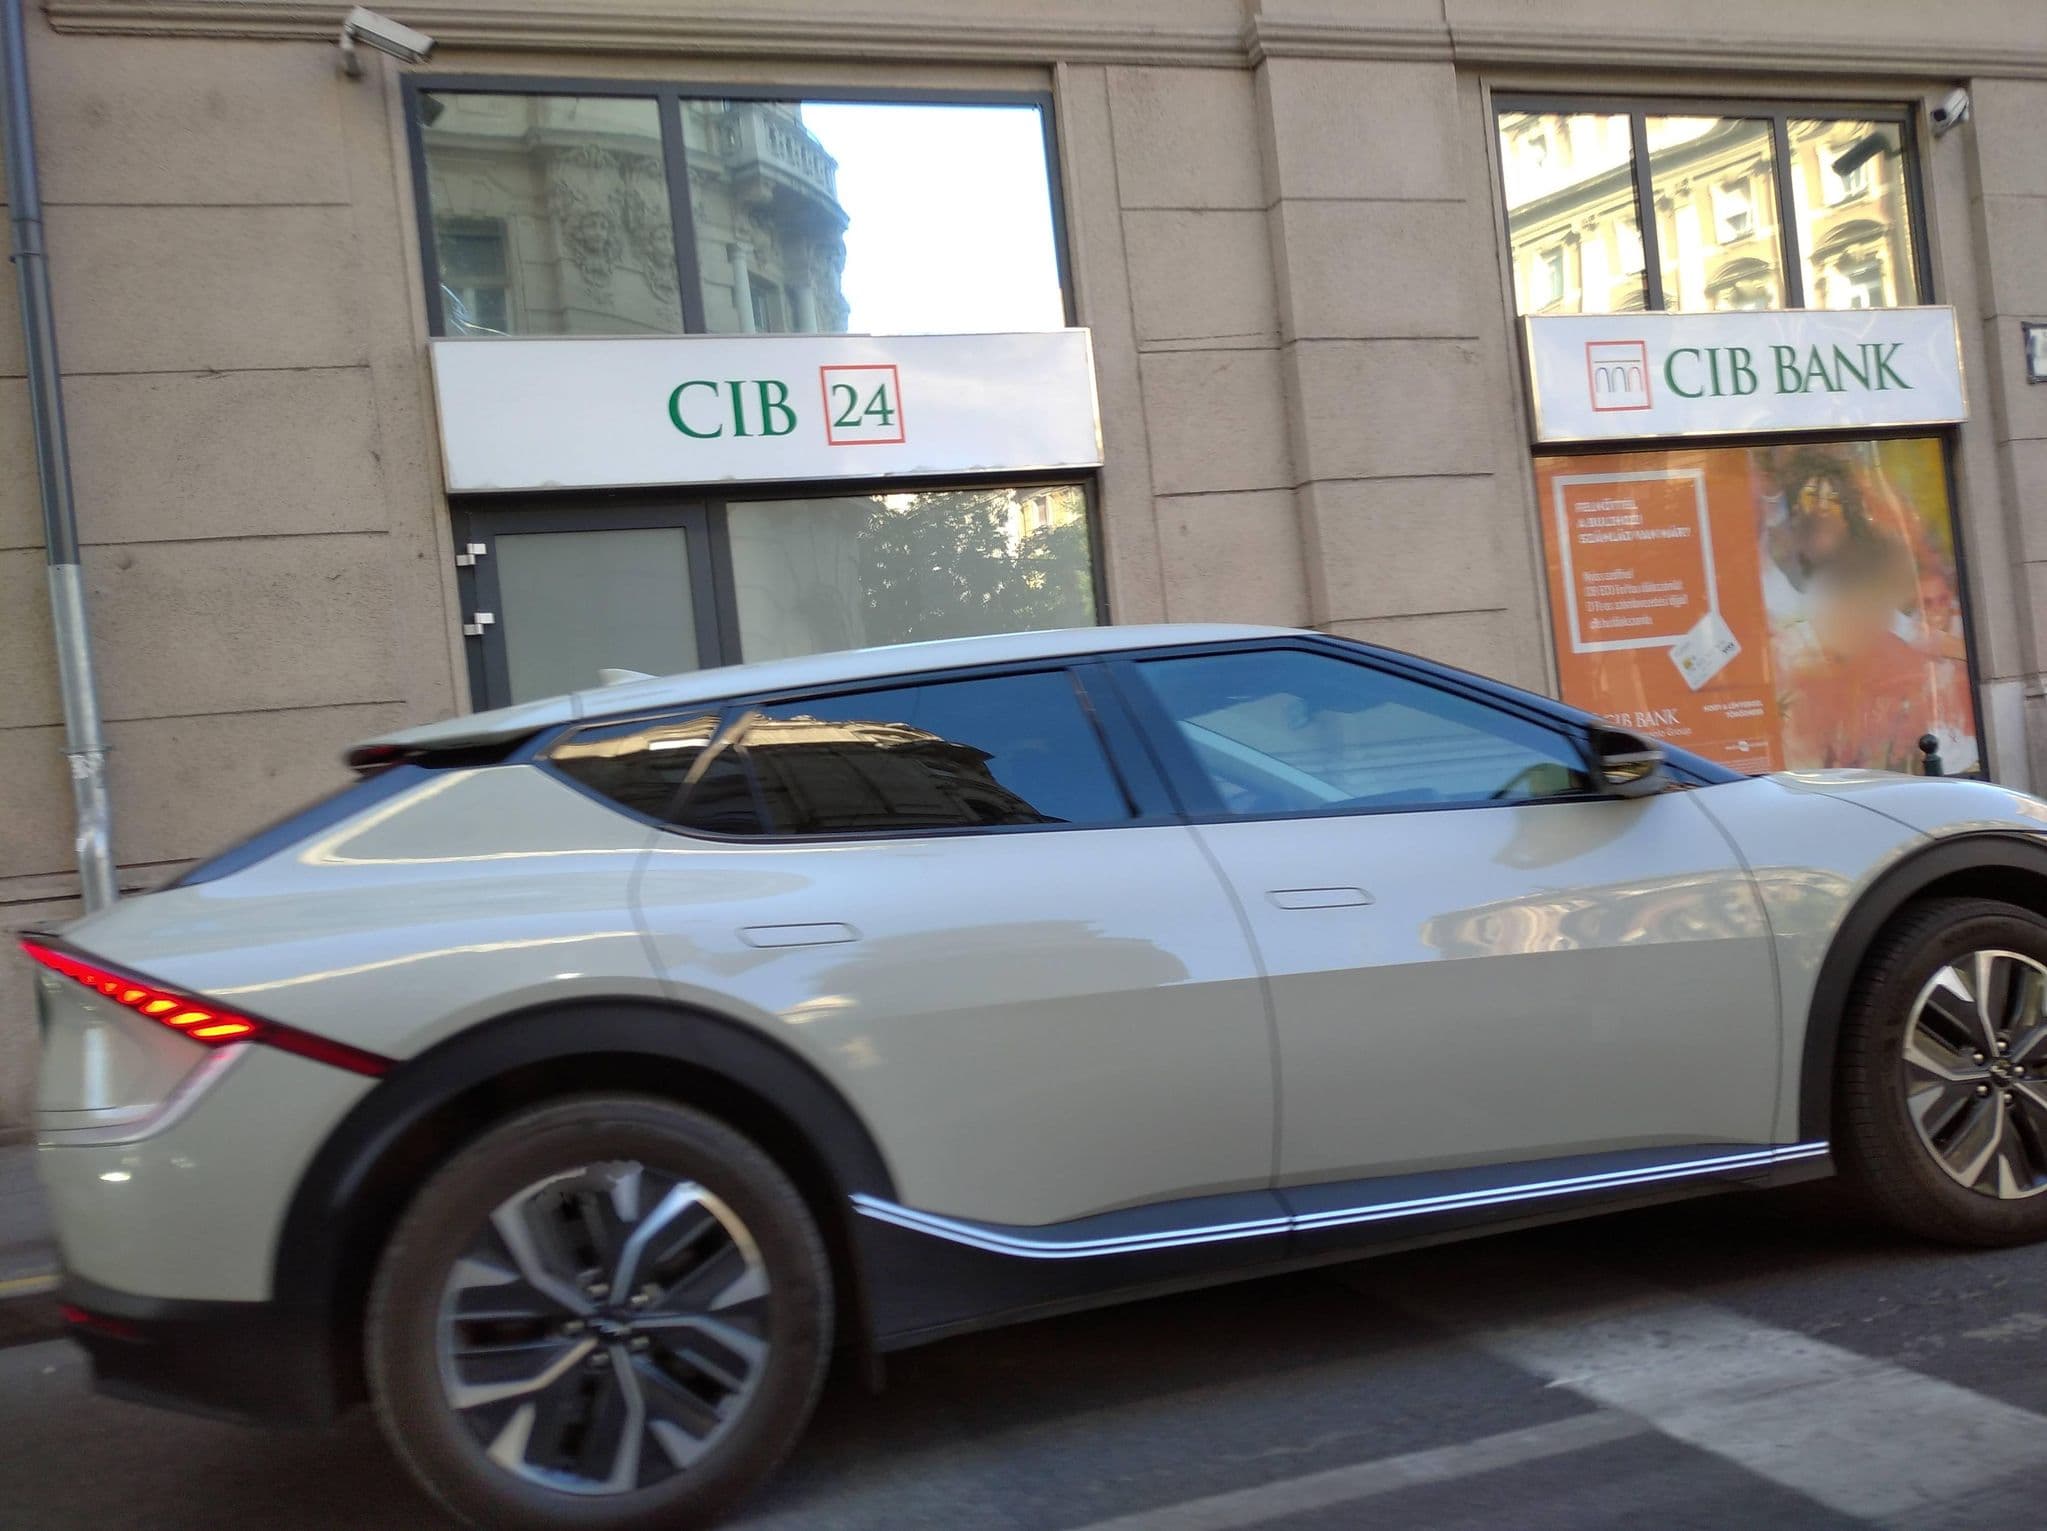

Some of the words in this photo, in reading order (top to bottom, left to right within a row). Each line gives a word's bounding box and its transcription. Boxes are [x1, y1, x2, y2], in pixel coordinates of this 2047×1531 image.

[1663, 347, 1757, 398] CIB
[1769, 342, 1914, 394] BANK
[668, 380, 797, 439] CIB
[832, 383, 895, 427] 24
[1633, 708, 1680, 728] BANK
